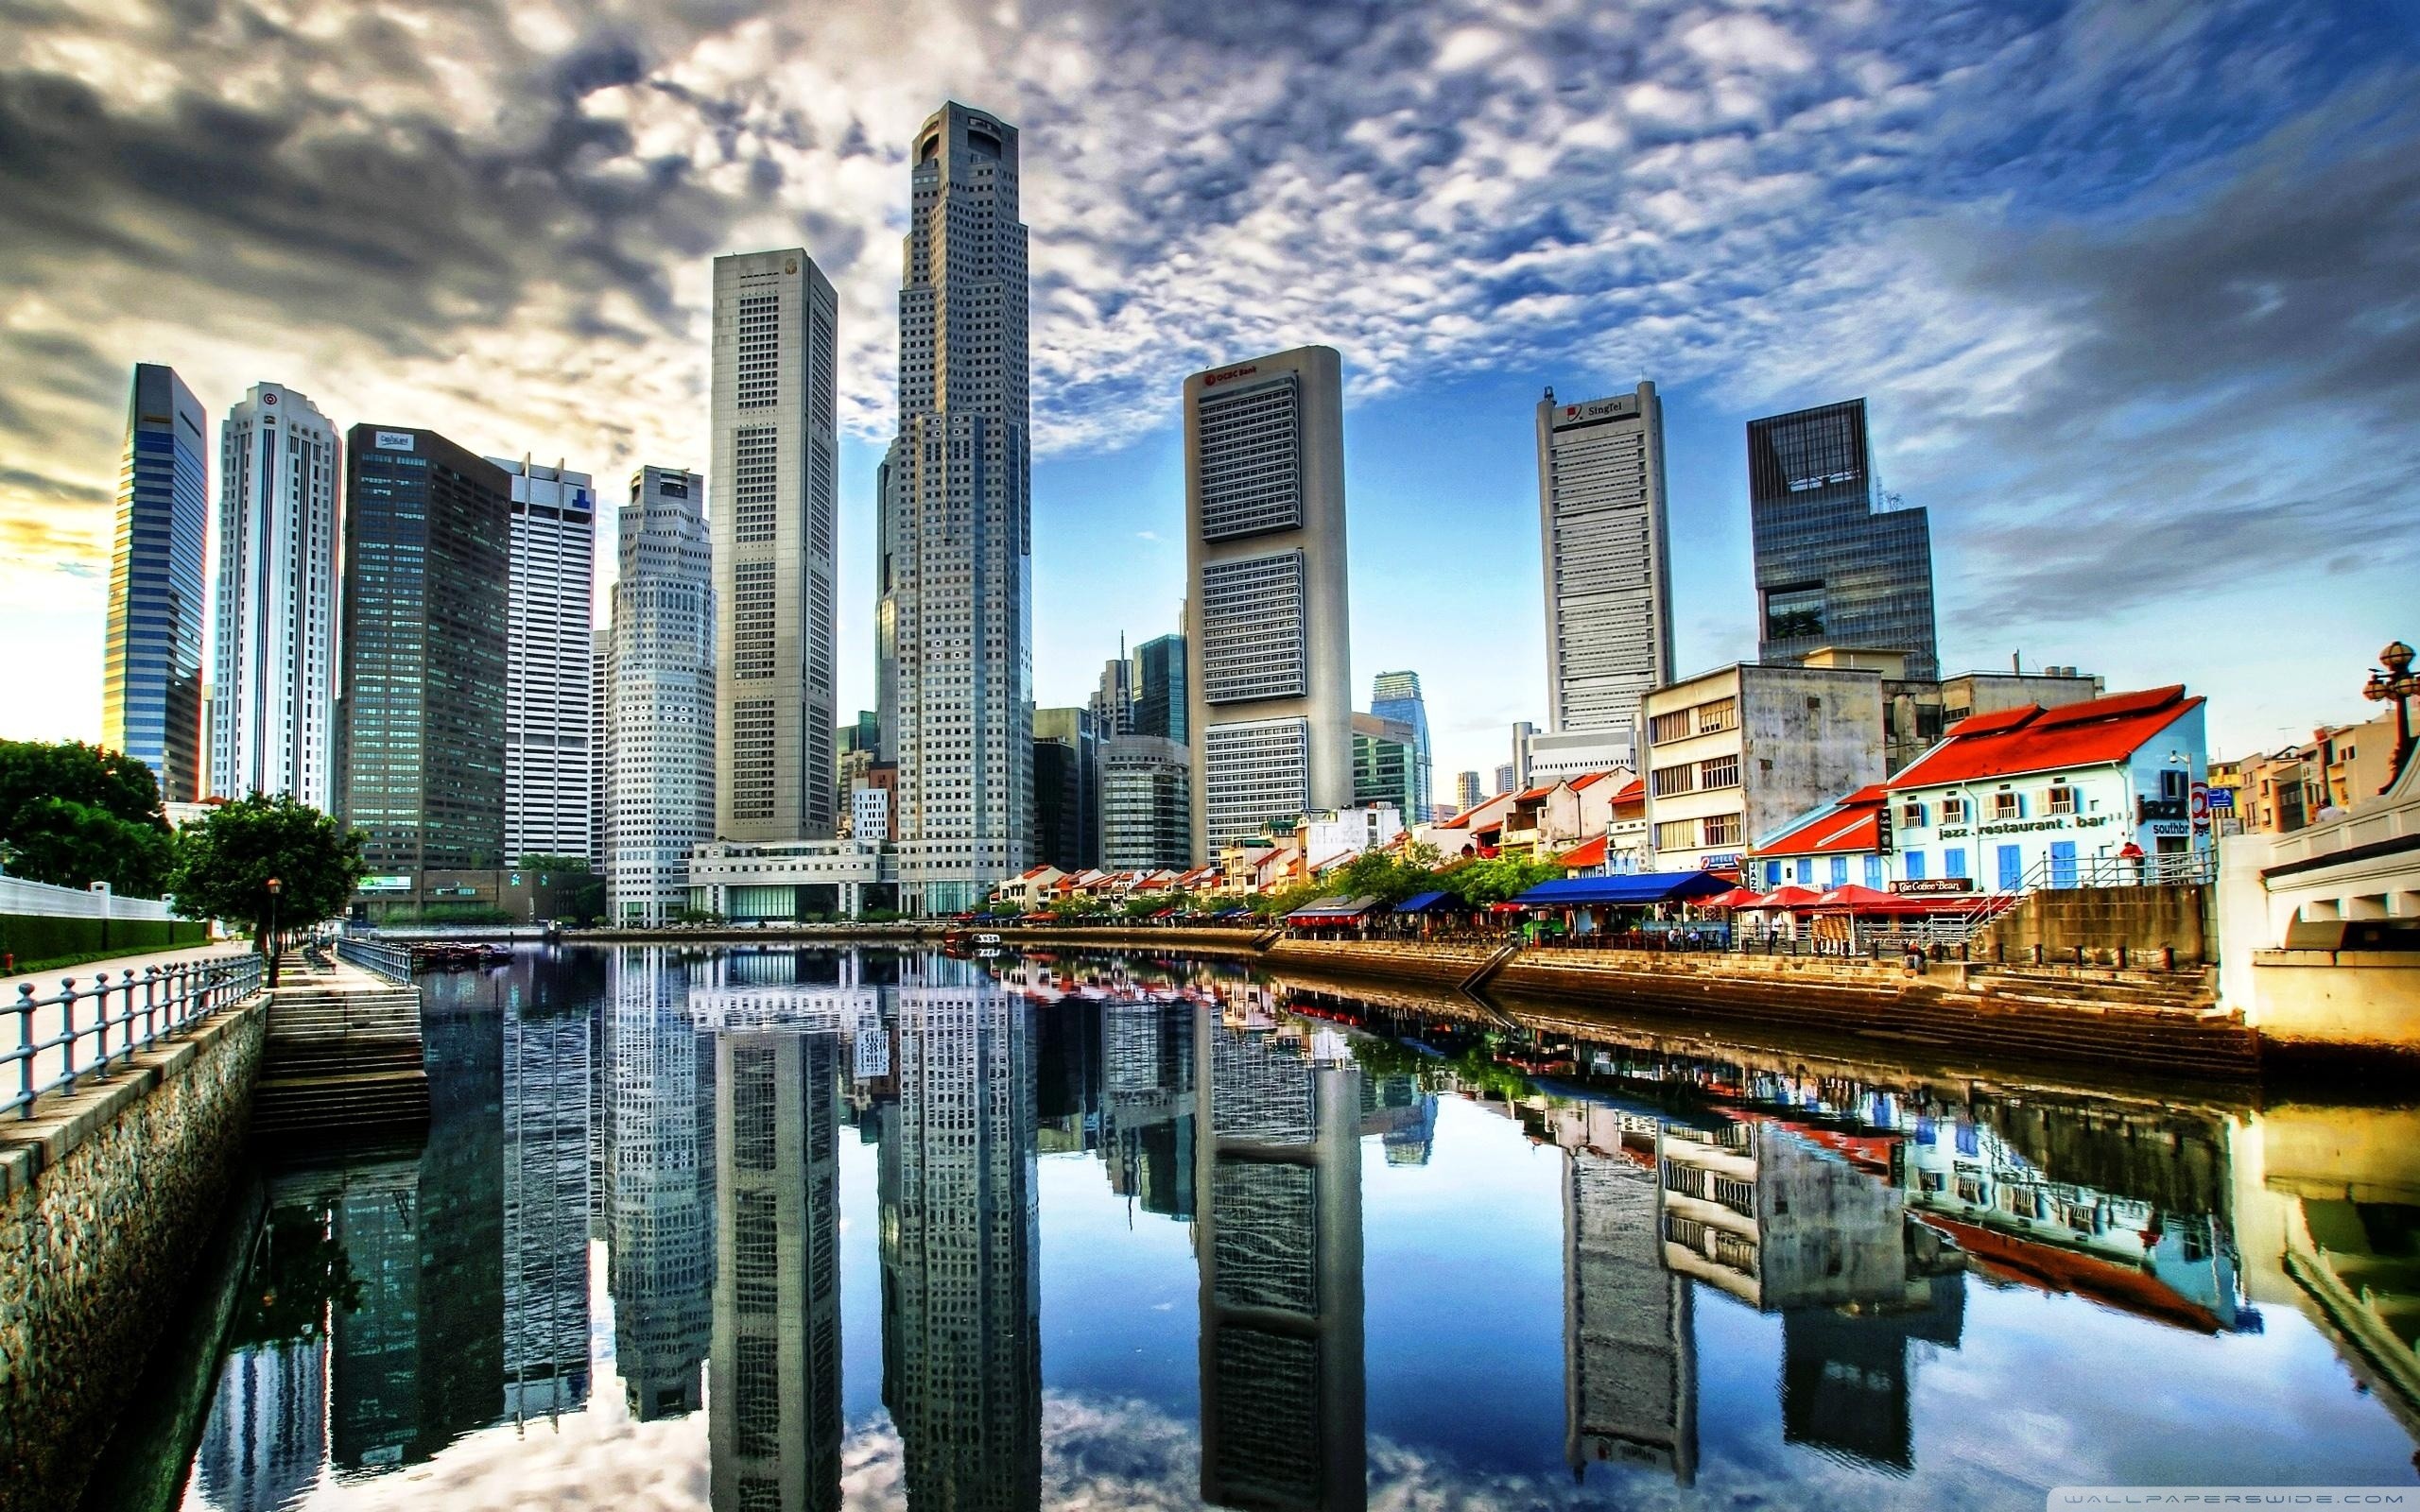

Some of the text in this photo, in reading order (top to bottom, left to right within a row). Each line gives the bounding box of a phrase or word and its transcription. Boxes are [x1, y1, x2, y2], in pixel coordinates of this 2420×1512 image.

[1217, 366, 1256, 381] OCBC Bank
[1588, 402, 1622, 416] SingTel
[1938, 815, 2107, 840] jazz restaurant bar
[1898, 880, 1961, 892] The Coffee Bean
